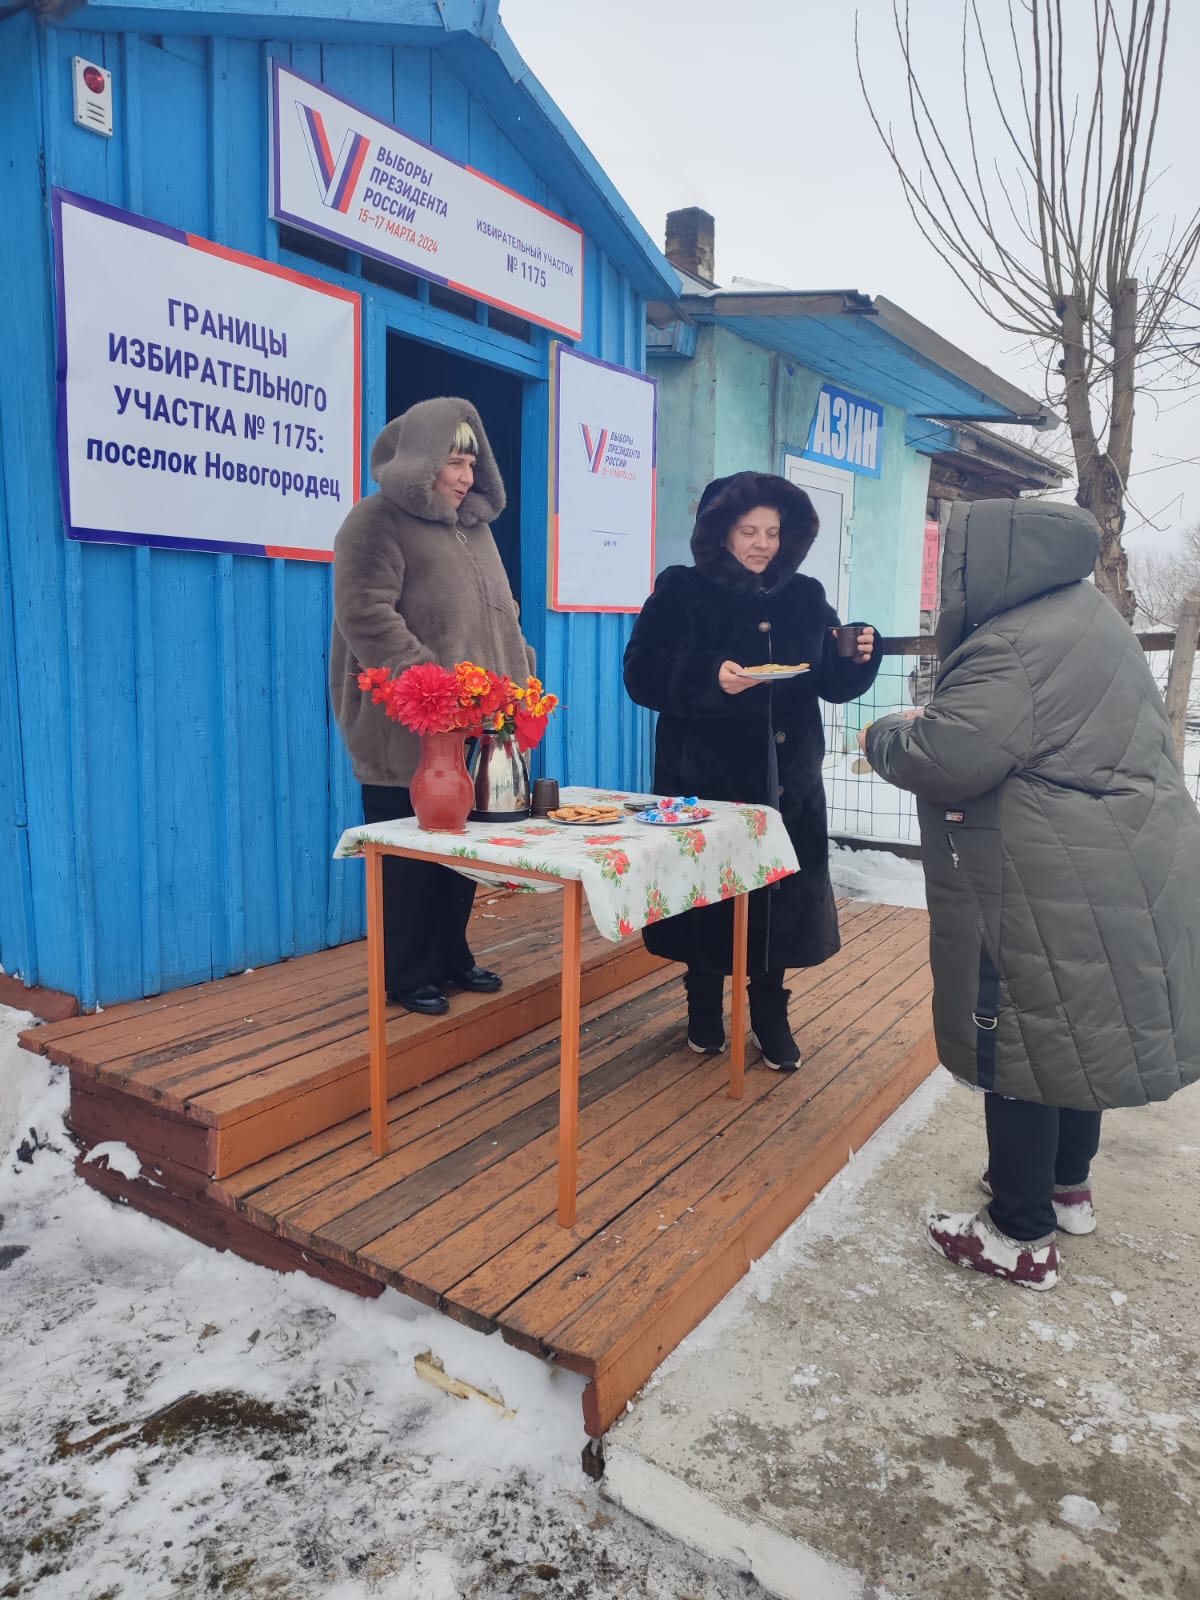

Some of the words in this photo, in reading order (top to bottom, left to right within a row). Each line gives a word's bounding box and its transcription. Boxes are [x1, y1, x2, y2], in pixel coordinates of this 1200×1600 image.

[376, 146, 433, 187] ВЫБОРЫ
[363, 186, 417, 224] РОССИИ
[369, 166, 448, 218] ПРЕЗИДЕНТА
[385, 220, 416, 244] МАРТА
[417, 234, 438, 254] 2024
[476, 218, 542, 262] ИЗБИРАТЕЛЬНЫЙ
[543, 252, 574, 277] УЧАСТОК
[507, 253, 518, 274] №
[521, 261, 546, 288] 1175
[168, 297, 287, 358] ГРАНИЦЫ
[108, 332, 327, 412] ИЗБИРАТЕЛЬНОГО
[114, 384, 237, 437] УЧАСТКА
[244, 412, 265, 440] №
[272, 420, 324, 453] 1175:
[610, 431, 634, 446] ВЫБОРЫ
[804, 390, 879, 470] АЗИН
[86, 437, 197, 476] поселок
[205, 451, 341, 502] Новогородец
[605, 455, 627, 468] РОССИИ
[608, 443, 641, 459] ПРЕЗИДЕНТА
